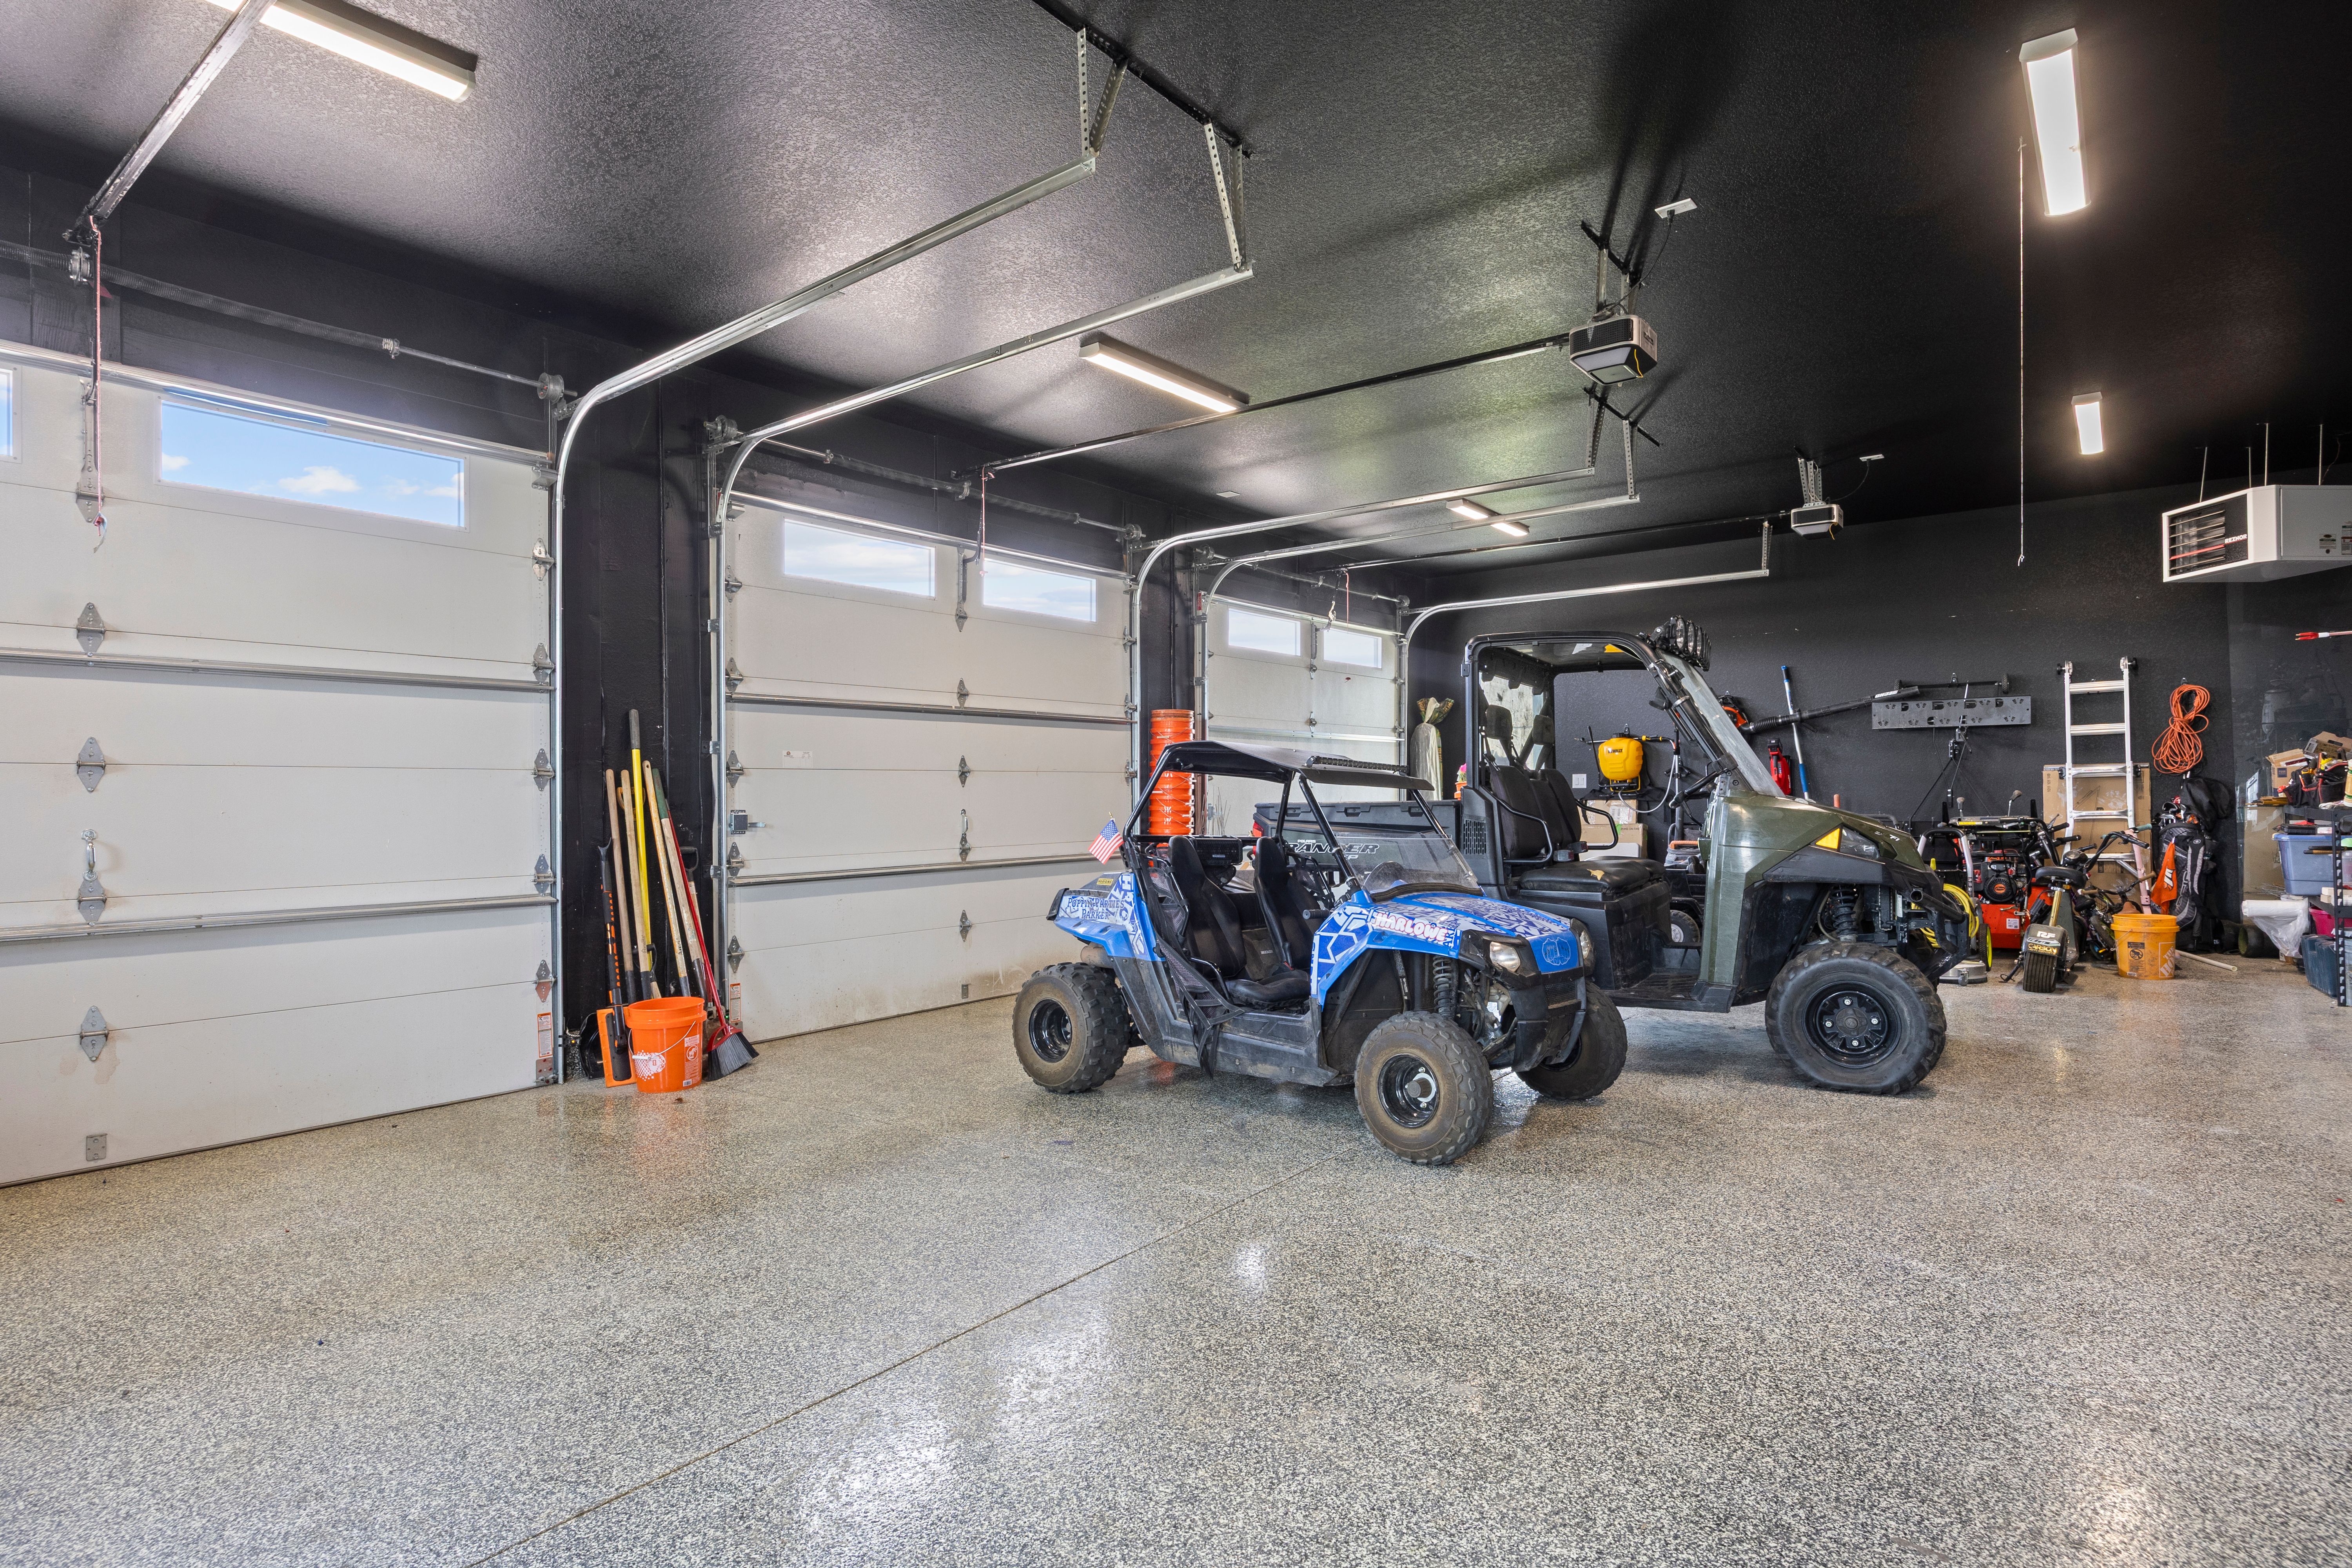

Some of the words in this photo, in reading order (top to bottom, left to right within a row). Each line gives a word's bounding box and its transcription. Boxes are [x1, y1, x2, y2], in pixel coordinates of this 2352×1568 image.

[2225, 534, 2247, 544] REZNOR
[1287, 843, 1380, 854] RANER
[1095, 898, 1125, 908] PARTIES
[1082, 909, 1109, 920] PARKER
[1375, 912, 1449, 941] HARLOWE
[2028, 943, 2057, 953] CARBON
